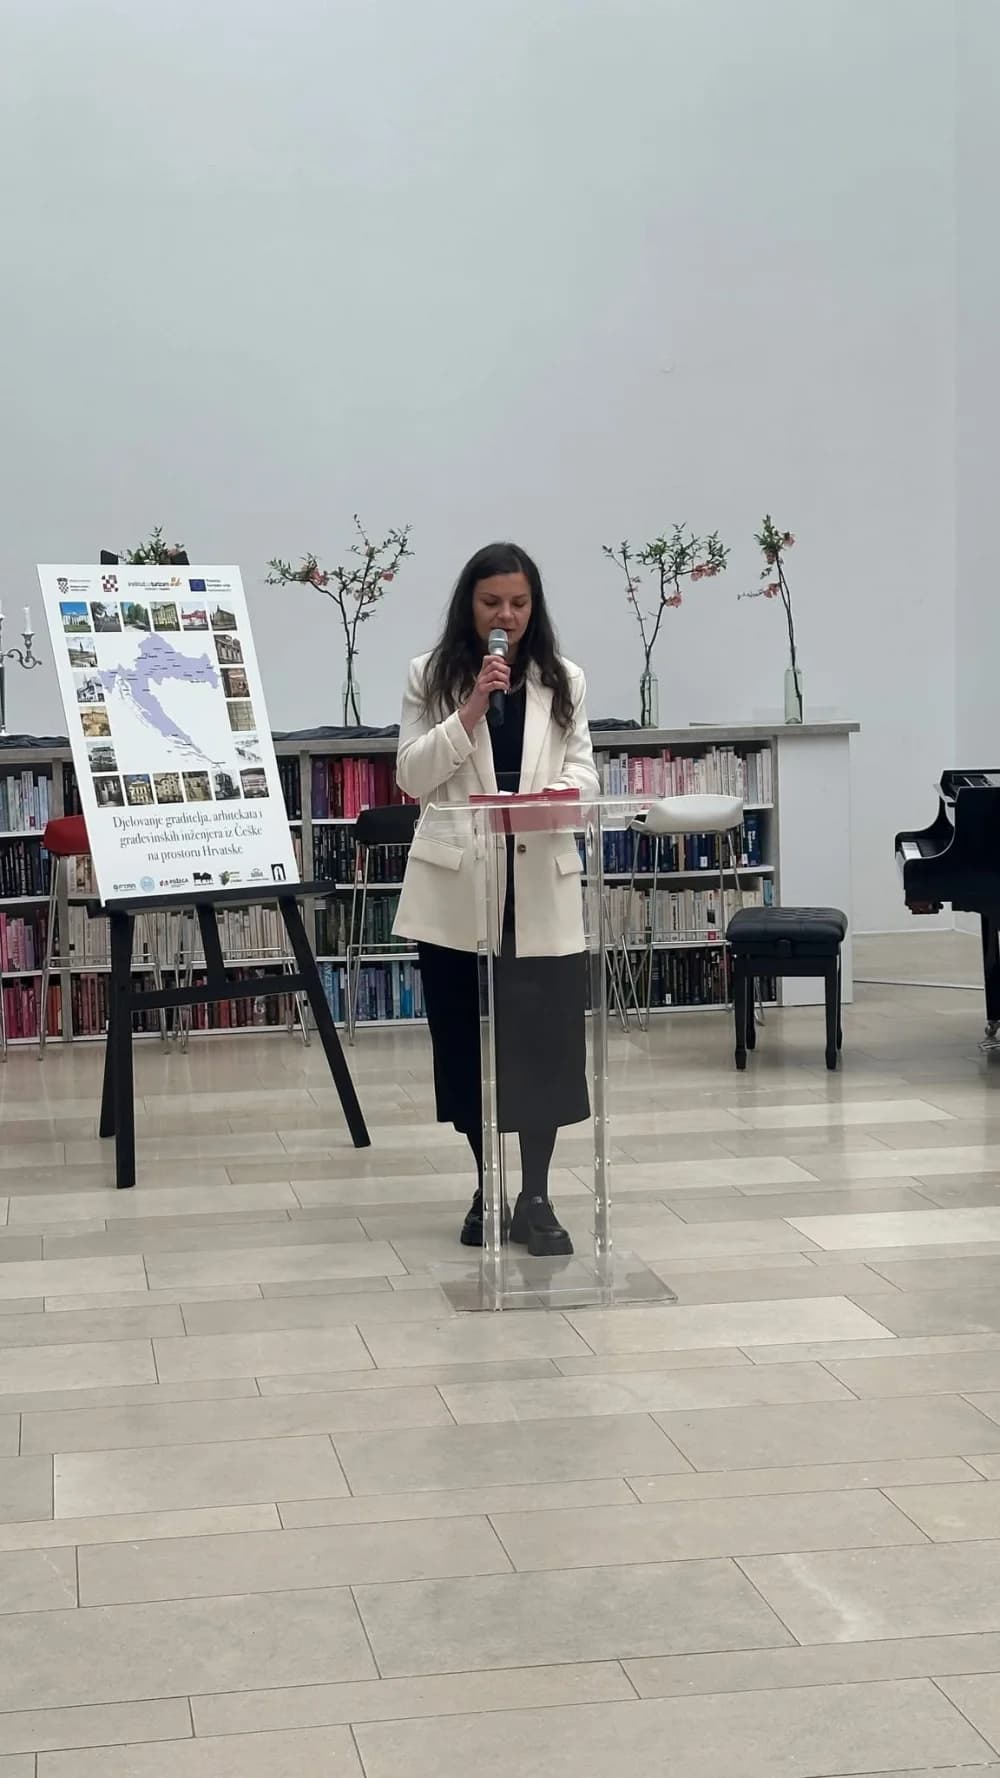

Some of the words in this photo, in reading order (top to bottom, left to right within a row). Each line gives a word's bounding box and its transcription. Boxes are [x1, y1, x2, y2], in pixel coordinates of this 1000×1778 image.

[112, 816, 162, 831] Djelovanje
[213, 809, 257, 821] arhitekata
[181, 827, 223, 842] inženjera
[224, 828, 233, 838] iz
[234, 822, 262, 837] Češke
[147, 852, 159, 862] na
[161, 848, 201, 863] prostoru
[202, 844, 243, 858] Hrvatske
